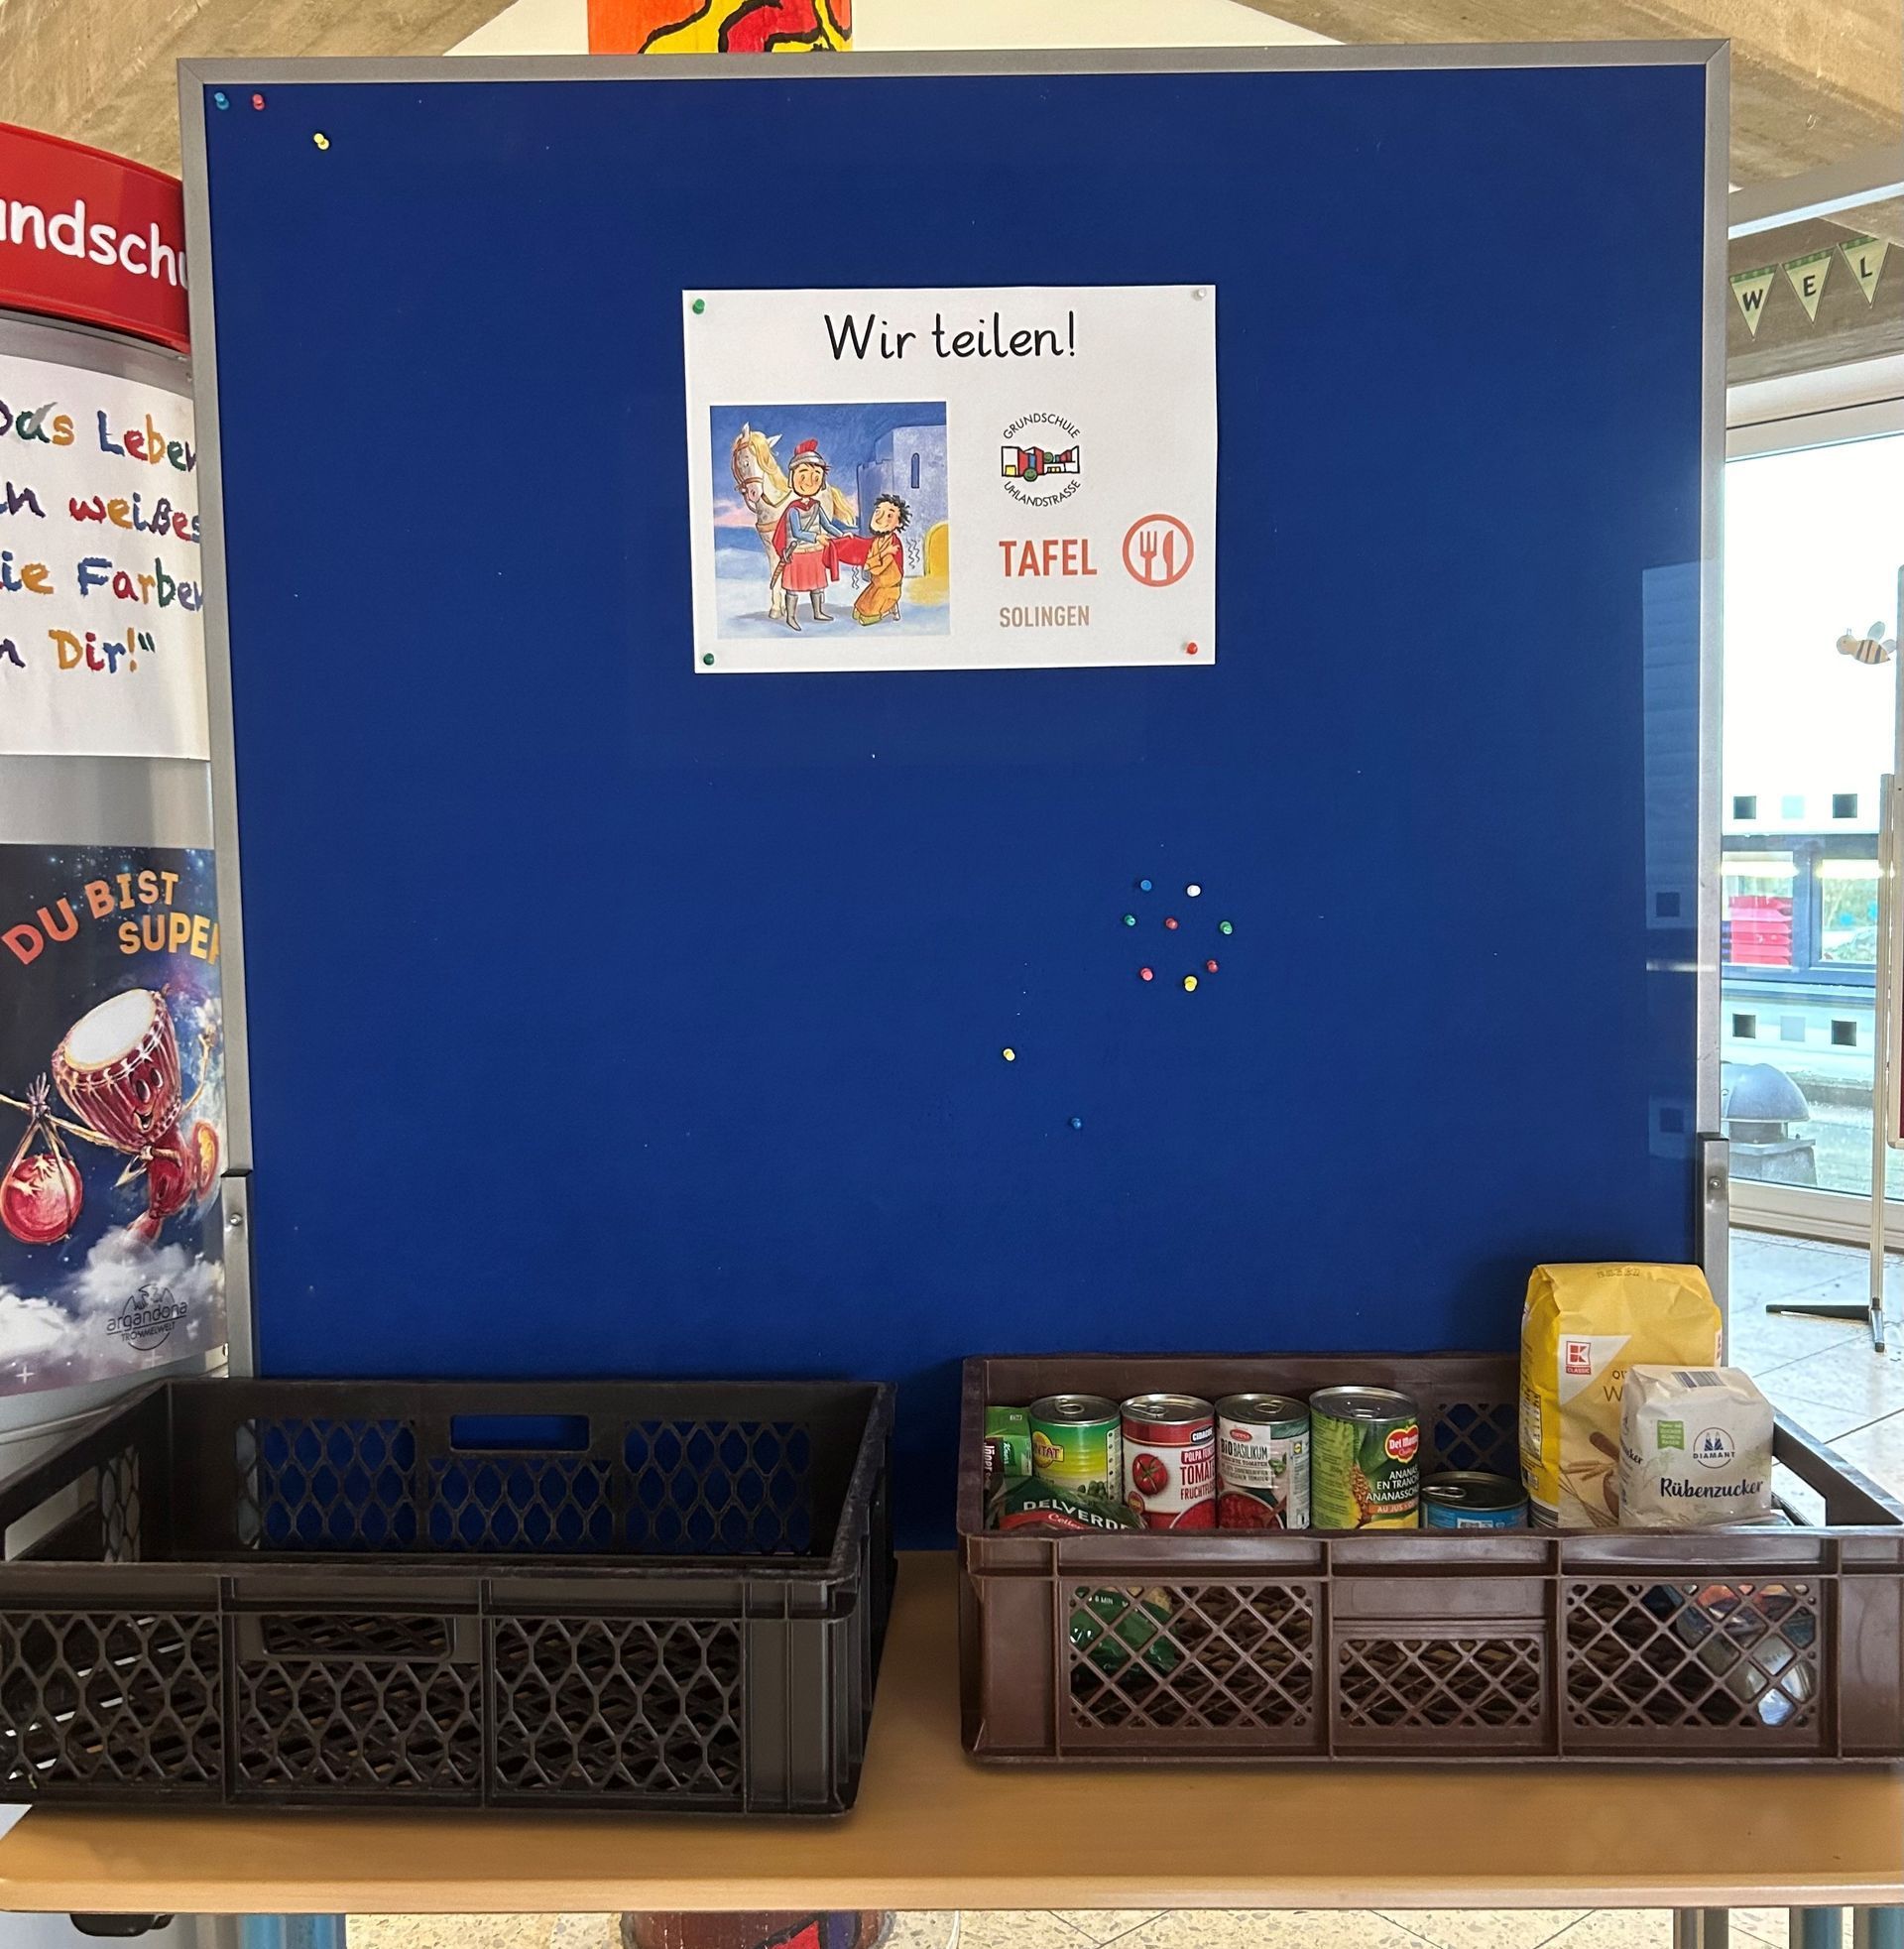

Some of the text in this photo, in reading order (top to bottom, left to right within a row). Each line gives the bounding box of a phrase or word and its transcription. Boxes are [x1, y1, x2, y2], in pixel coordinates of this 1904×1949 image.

[824, 310, 1077, 360] Wir teilen!
[1003, 413, 1081, 439] GRUNDSCHULE
[1004, 479, 1082, 507] UHLANDSTRASSE
[999, 538, 1098, 578] TAFEL
[0, 550, 54, 595] ie
[999, 604, 1090, 628] SOLINGEN
[0, 869, 178, 965] DU BIST
[1388, 1438, 1402, 1449] Del
[1376, 1481, 1390, 1490] EN
[1660, 1477, 1764, 1499] Rübenzucker
